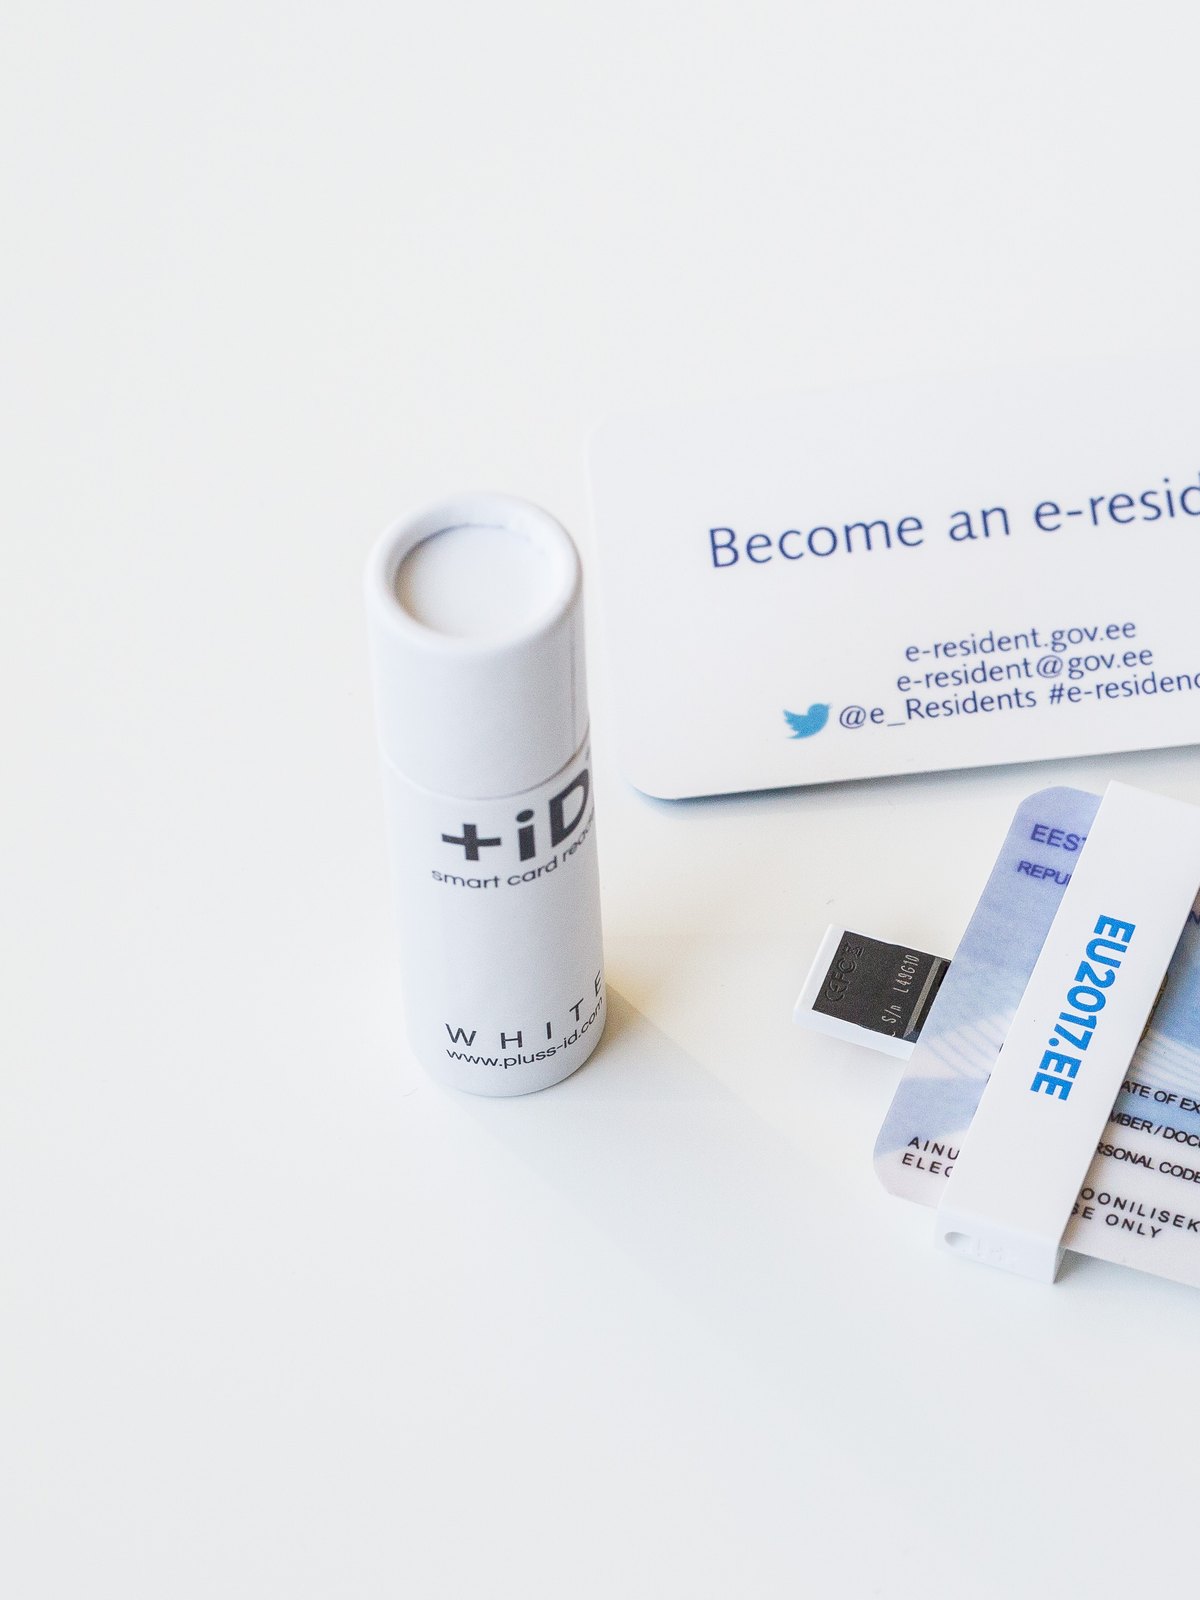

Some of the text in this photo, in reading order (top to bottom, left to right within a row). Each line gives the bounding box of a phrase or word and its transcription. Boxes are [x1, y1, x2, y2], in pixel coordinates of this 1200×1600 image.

[709, 515, 924, 568] Become
[949, 507, 1010, 542] an
[905, 622, 1136, 662] e-resident.gov.ee
[896, 648, 1155, 692] e-resident@gov.ee
[839, 686, 1037, 730] @e_Residents
[1030, 823, 1087, 852] EES
[431, 870, 500, 889] smart
[507, 856, 558, 887] card
[1017, 860, 1072, 887] REPU
[1030, 914, 1136, 1101] EU2017.EE
[446, 996, 603, 1069] www.pluss-id.com
[1121, 1080, 1151, 1099] ATE
[1153, 1090, 1178, 1105] OF
[1108, 1110, 1153, 1134] MBER
[907, 1136, 960, 1161] AINU
[1097, 1141, 1155, 1170] RSONAL
[901, 1152, 954, 1178] ELEC
[1105, 1213, 1162, 1239] ONLY
